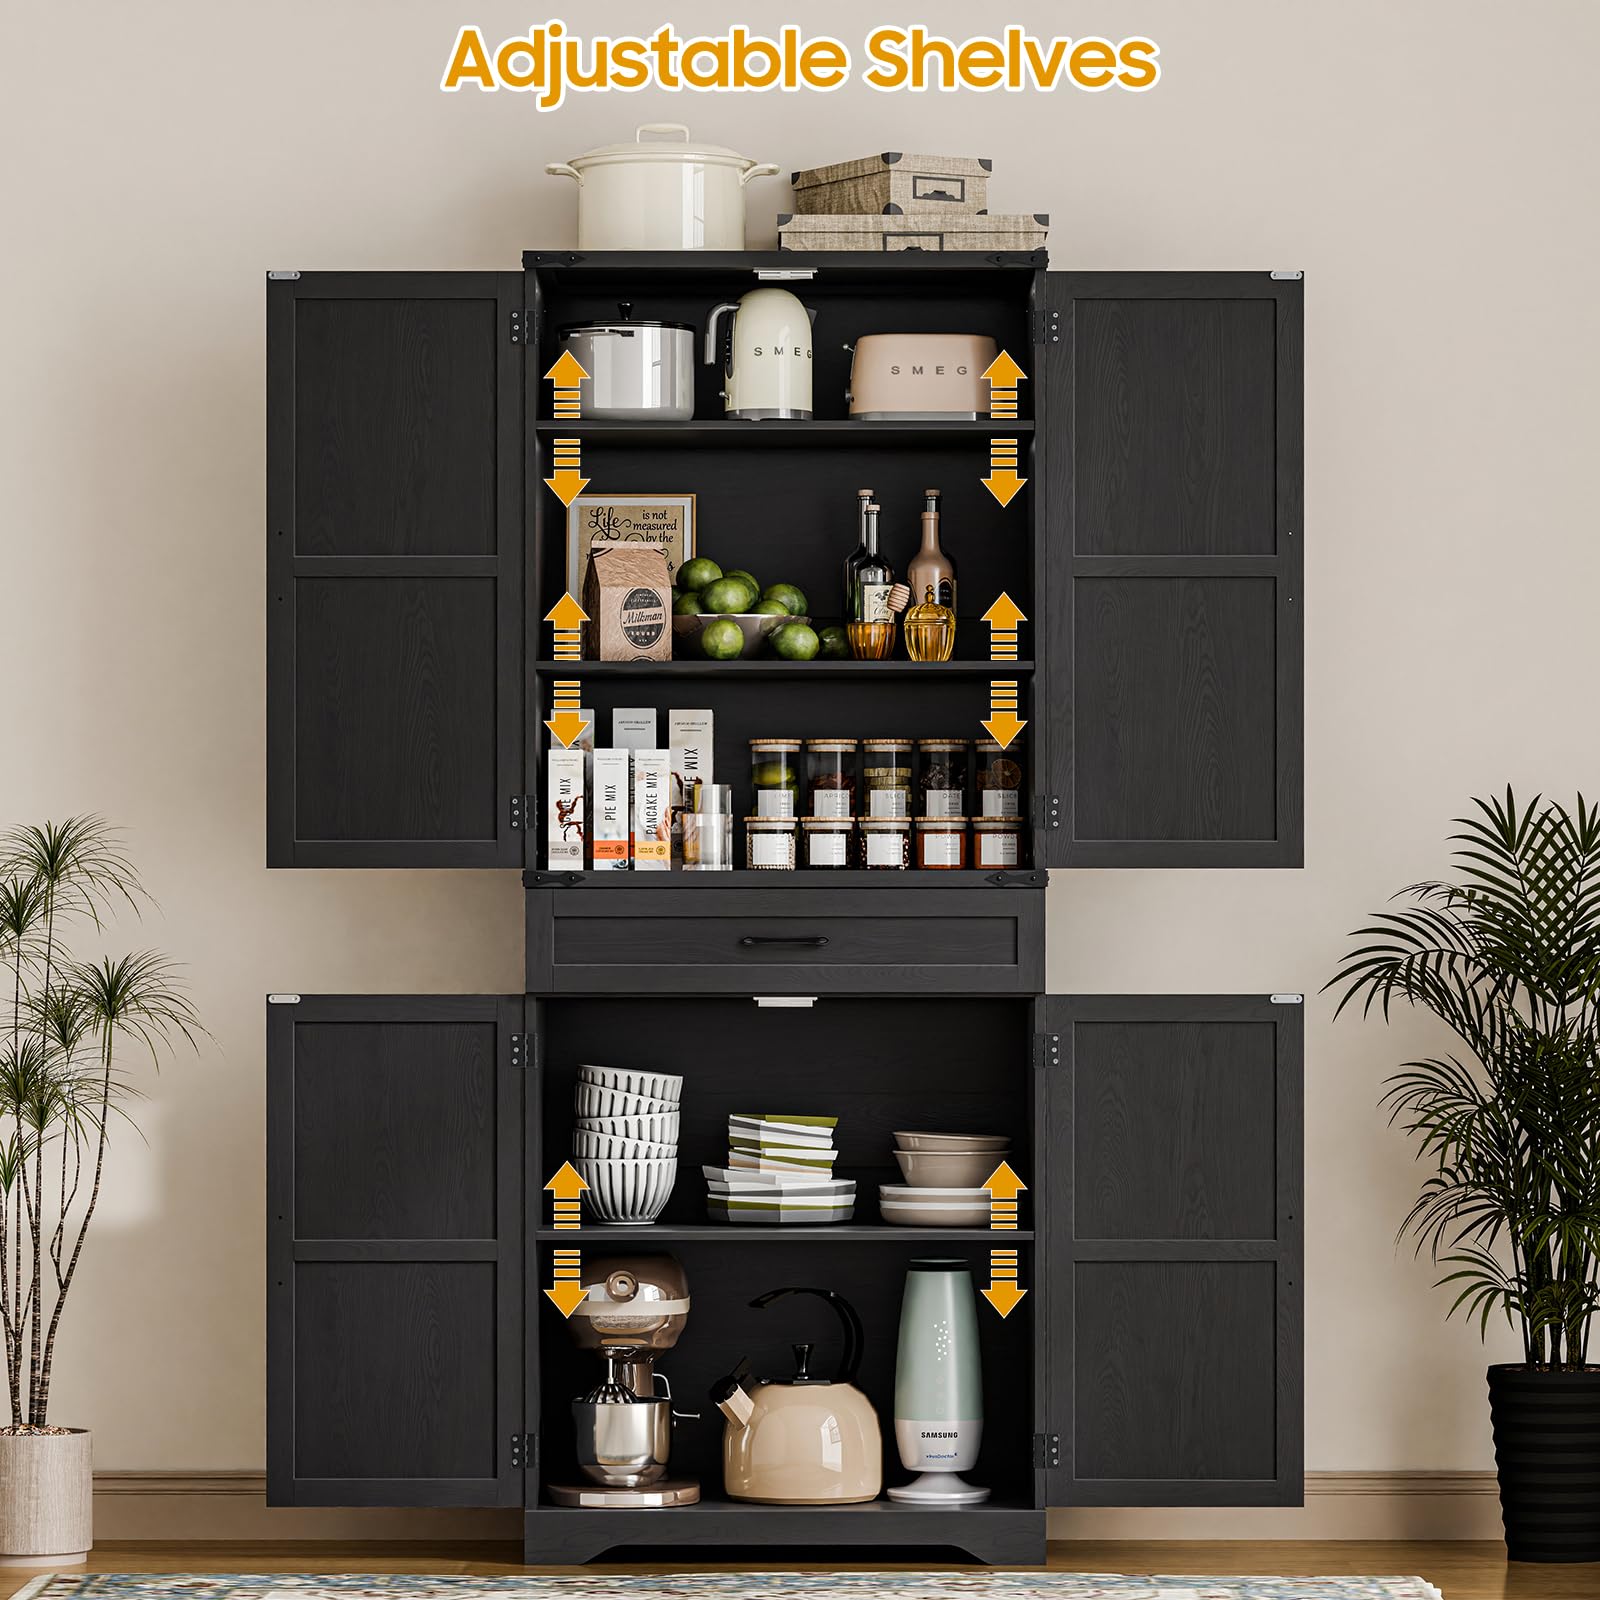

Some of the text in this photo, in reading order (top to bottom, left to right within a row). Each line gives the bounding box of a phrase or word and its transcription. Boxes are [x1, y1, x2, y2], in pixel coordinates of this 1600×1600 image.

[754, 347, 812, 359] SMEG
[890, 365, 968, 376] SMEG
[642, 509, 668, 520] is not
[588, 506, 632, 541] Life
[633, 518, 678, 531] measured
[659, 531, 674, 543] the
[624, 611, 662, 625] Milkman
[560, 778, 571, 795] MIX
[646, 771, 657, 790] MIX
[605, 784, 616, 821] PIE MIX
[646, 793, 657, 835] PANCAKE
[921, 1431, 958, 1439] SAMSUNG
